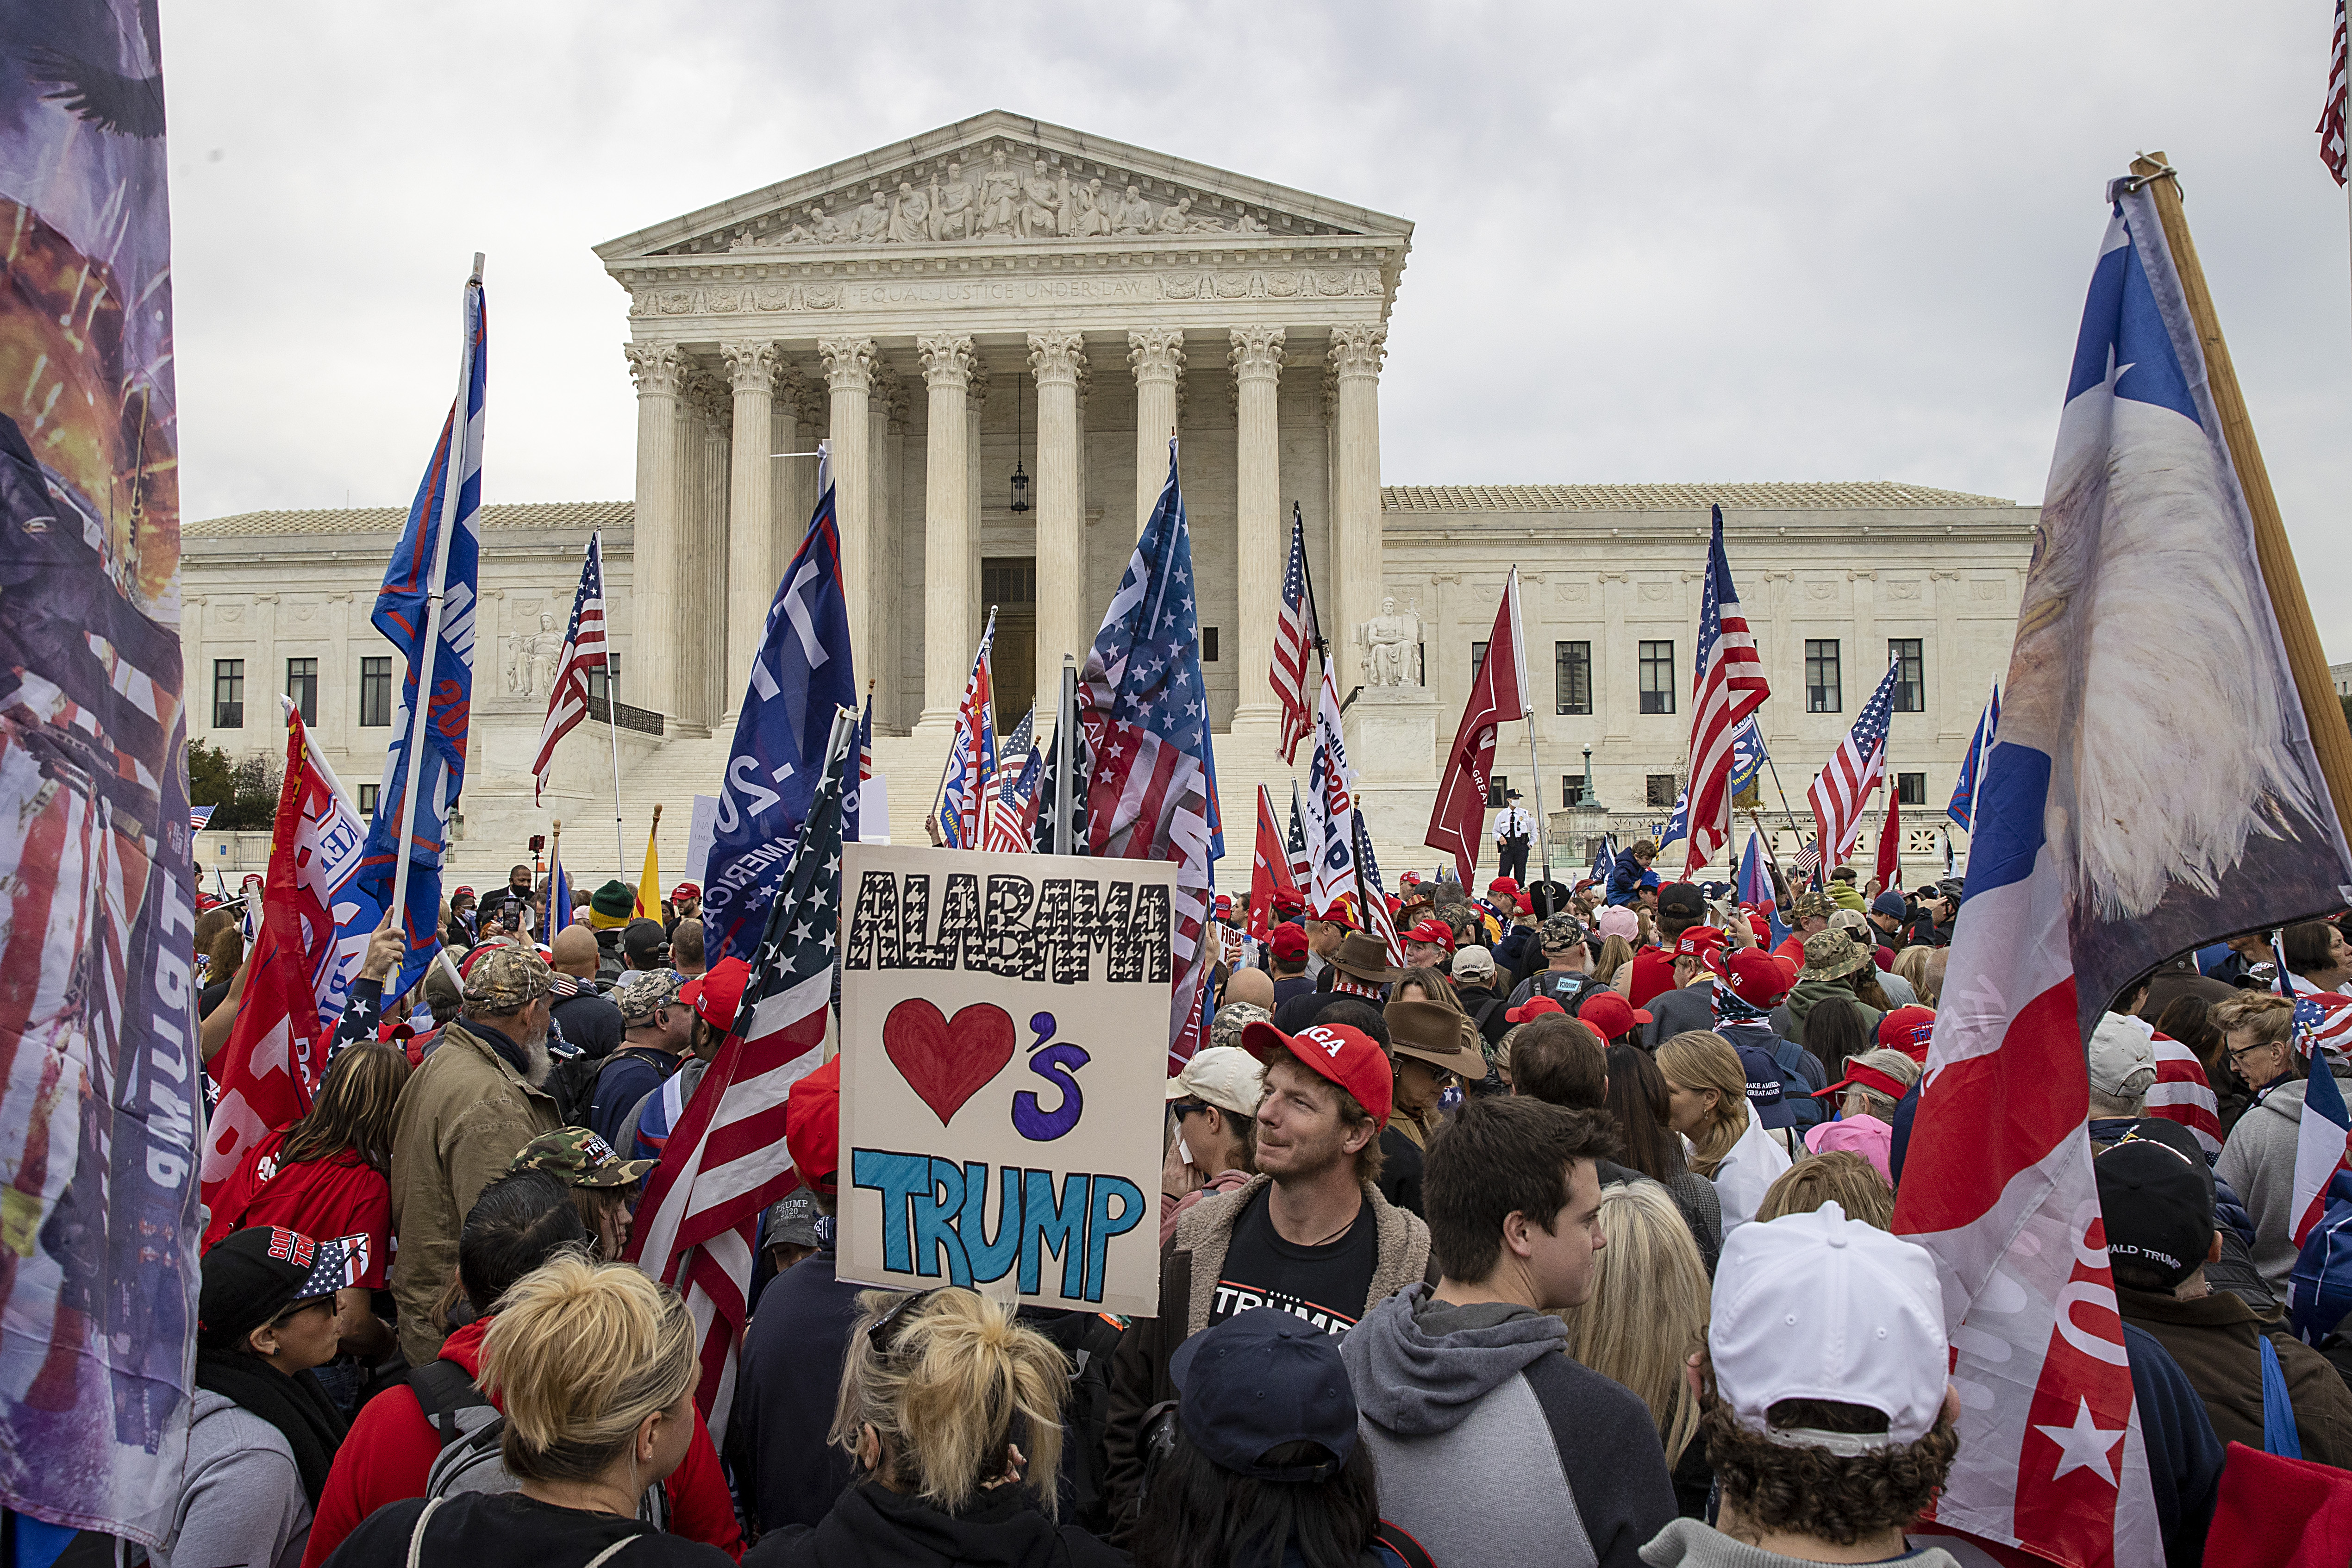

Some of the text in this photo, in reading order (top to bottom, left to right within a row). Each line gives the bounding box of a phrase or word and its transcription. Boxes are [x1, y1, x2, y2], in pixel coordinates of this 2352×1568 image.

[860, 281, 1143, 304] EQUAL JUSTICE UNDER LAW
[845, 870, 1170, 984] ALABAMA
[1221, 925, 1244, 946] FIGH
[1248, 951, 1258, 964] FIJI
[1731, 972, 1743, 987] 45
[594, 1156, 606, 1166] MAKE
[775, 1199, 808, 1214] TRUMP
[781, 1207, 798, 1218] 2020
[851, 1147, 1146, 1304] TRUMP
[268, 1230, 291, 1259] GOD
[2142, 1249, 2182, 1270] TRUMP
